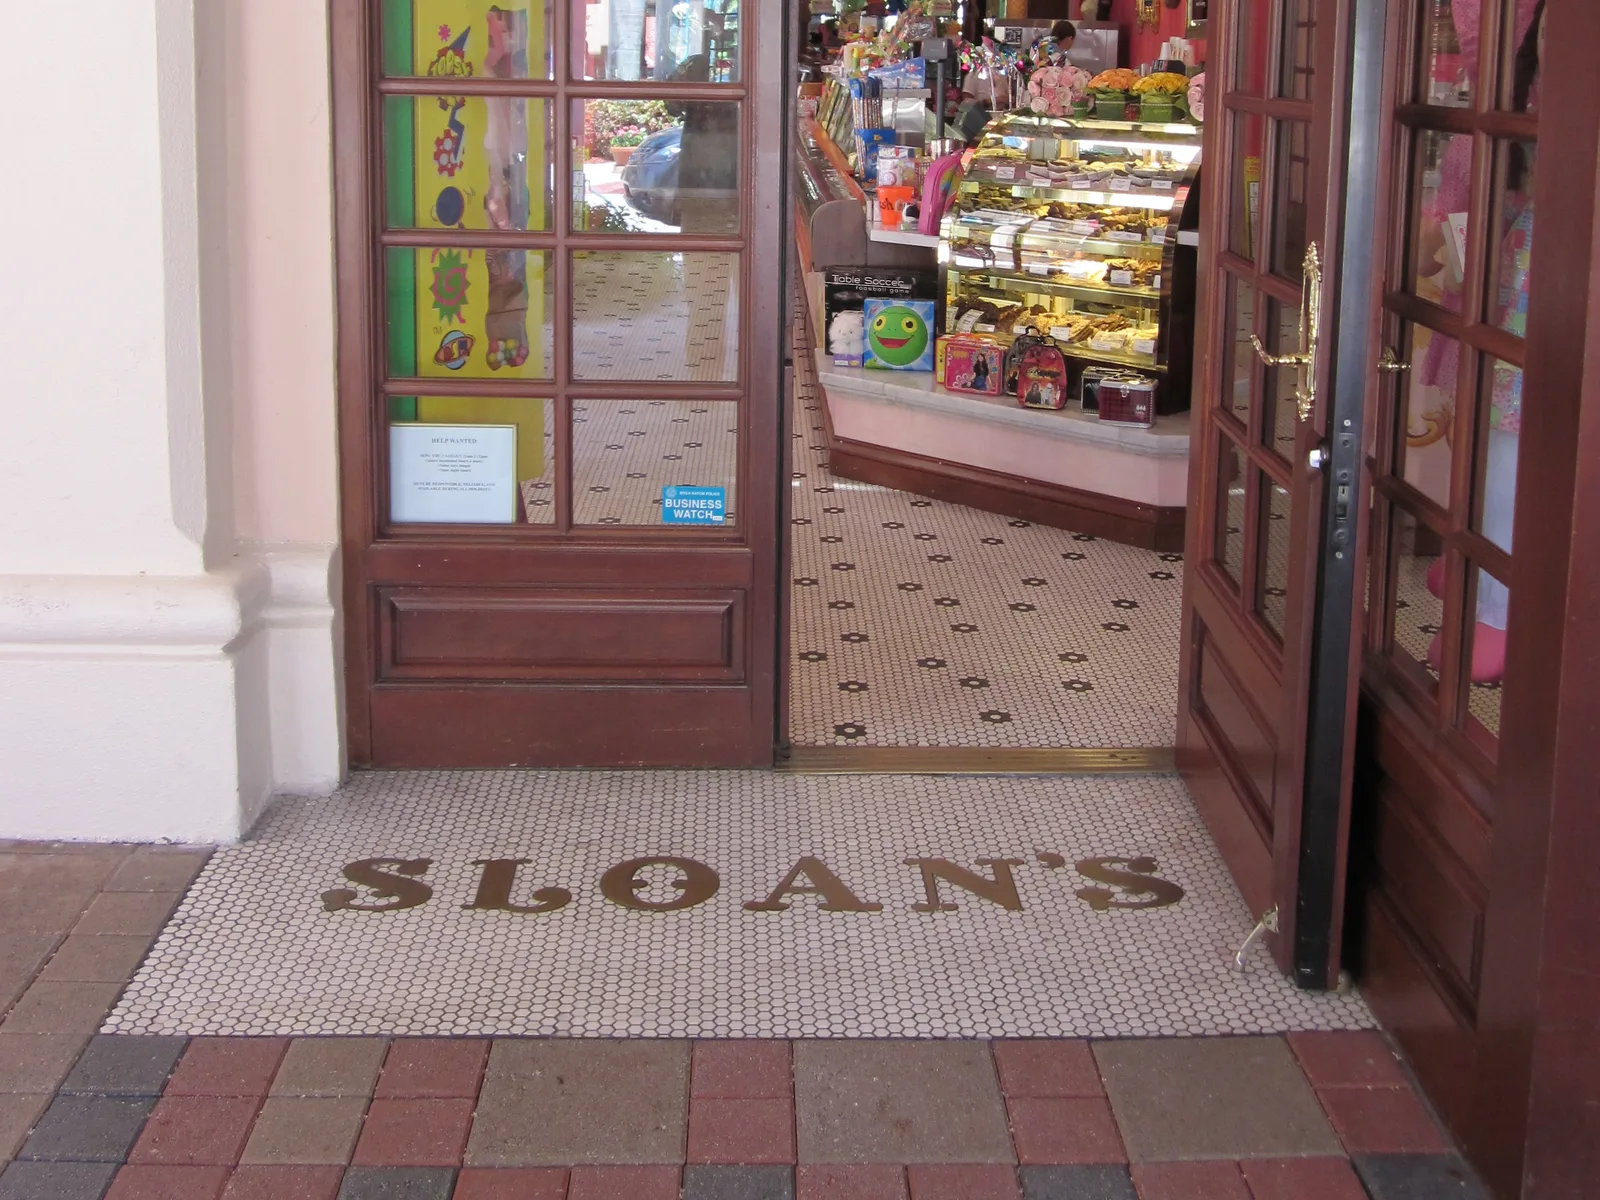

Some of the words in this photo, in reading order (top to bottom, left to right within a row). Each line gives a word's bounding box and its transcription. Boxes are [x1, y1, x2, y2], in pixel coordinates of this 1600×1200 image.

[832, 274, 861, 284] Table
[864, 276, 904, 287] Soccer
[665, 498, 722, 510] BUSINESS
[673, 510, 713, 519] WATCH
[320, 850, 1185, 914] SLOAN'S
